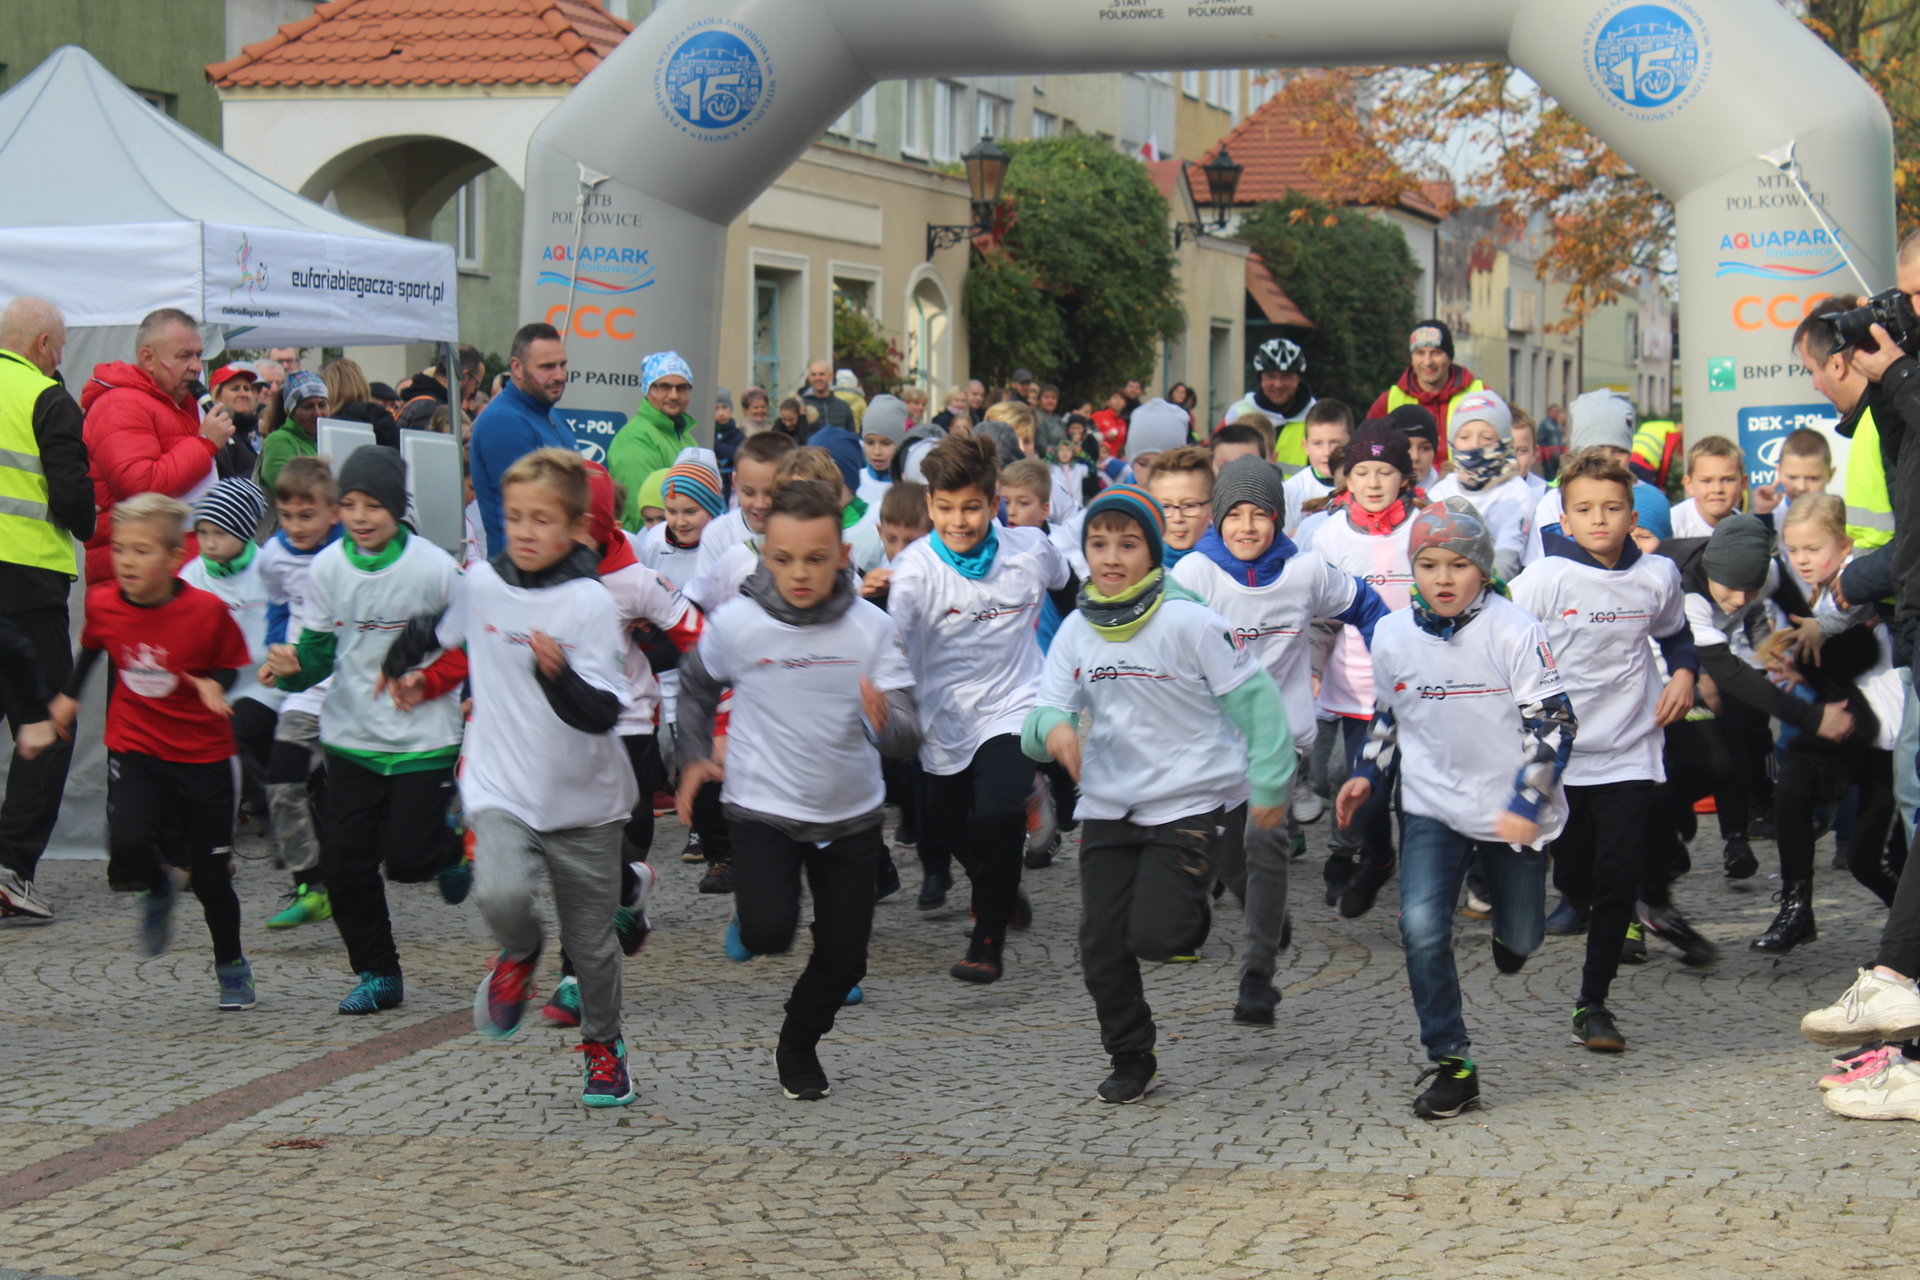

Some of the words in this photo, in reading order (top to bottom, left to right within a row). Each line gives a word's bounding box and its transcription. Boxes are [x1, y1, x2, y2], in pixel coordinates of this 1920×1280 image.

[1099, 9, 1165, 20] POLKOWICE
[1188, 6, 1254, 17] POLKOWICE
[1610, 46, 1676, 101] 15
[678, 72, 742, 121] 15
[1720, 228, 1841, 250] AQUAPARK
[542, 245, 649, 265] AQUAPARK
[1766, 246, 1833, 259] Polkowice
[577, 261, 639, 275] Polkowice
[291, 267, 444, 306] euforiabiegacza-sport.pl
[545, 304, 636, 341] CCC
[586, 371, 642, 387] PARIB
[1743, 364, 1782, 379] BNP
[1589, 611, 1616, 624] 100
[1088, 666, 1118, 682] 100
[1417, 685, 1446, 700] 100
